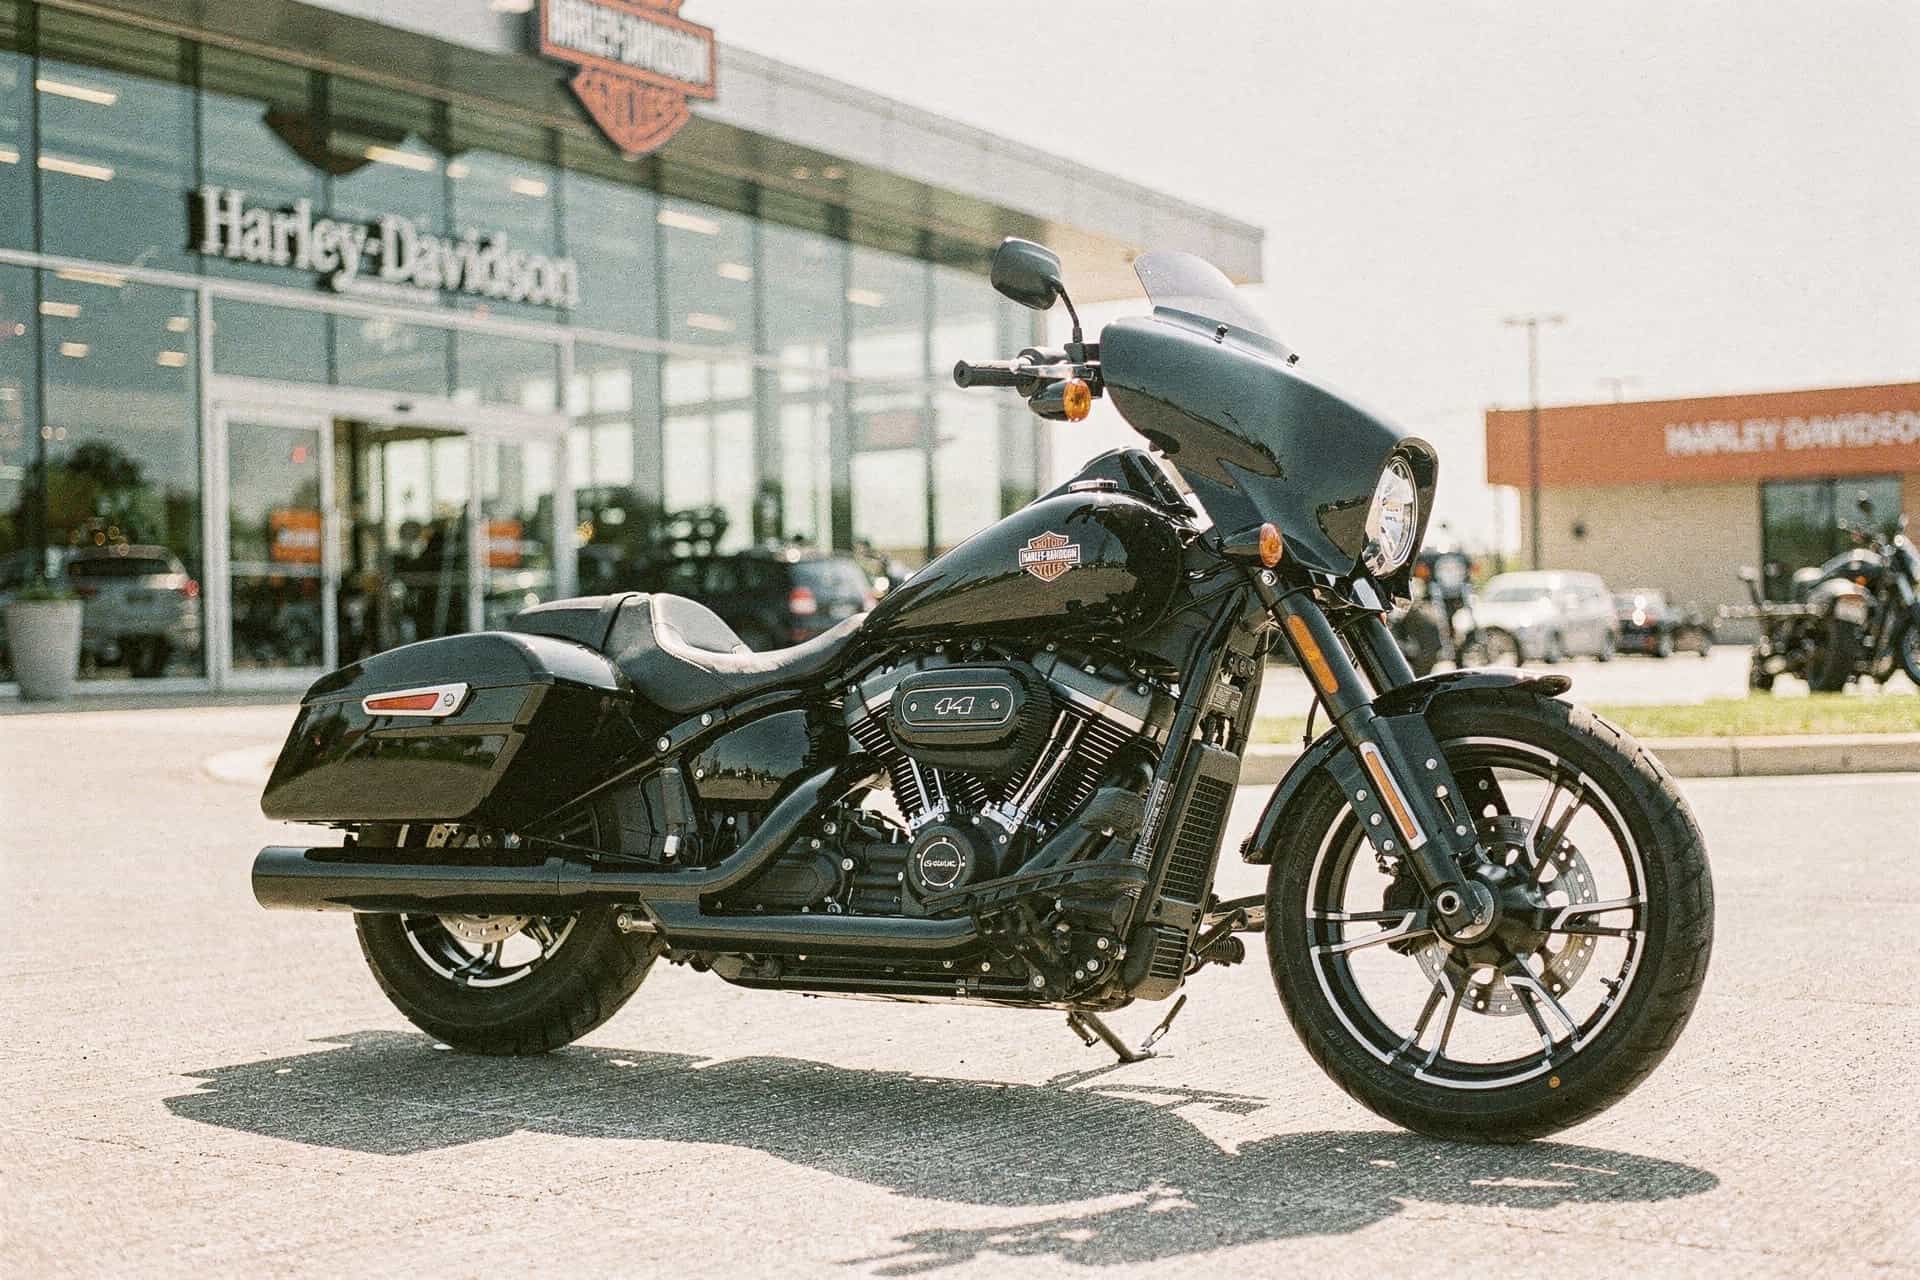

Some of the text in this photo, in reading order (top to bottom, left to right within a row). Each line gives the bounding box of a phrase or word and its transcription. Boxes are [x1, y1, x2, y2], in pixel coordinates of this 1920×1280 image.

[201, 185, 578, 305] Harley-Davidson
[1665, 411, 1920, 455] HARLEY DAVIDSO
